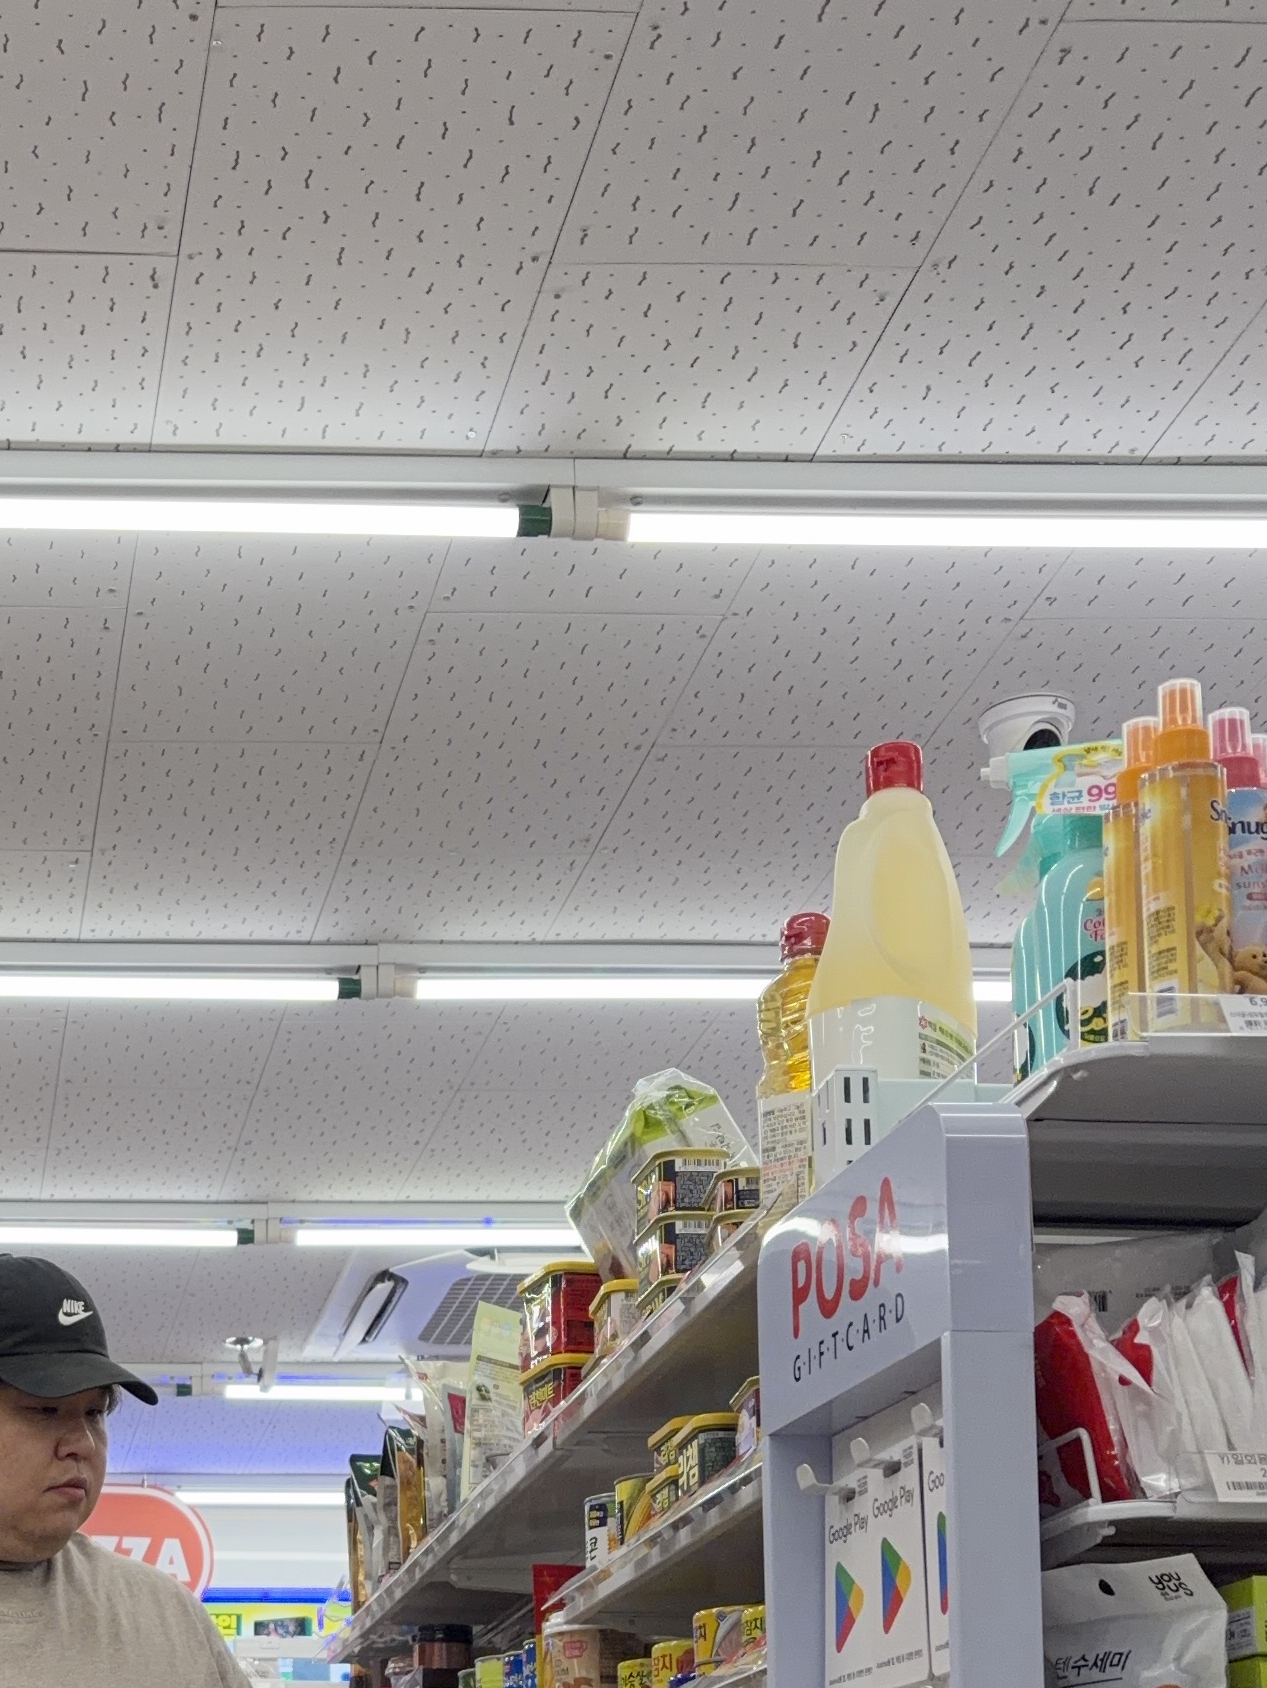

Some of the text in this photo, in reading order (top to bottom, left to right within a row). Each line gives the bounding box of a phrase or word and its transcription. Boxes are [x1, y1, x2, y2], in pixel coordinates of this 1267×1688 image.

[790, 1175, 904, 1340] POSA
[62, 1297, 85, 1315] NIKE
[872, 1484, 915, 1519] Google Play
[828, 1511, 869, 1545] Google Play
